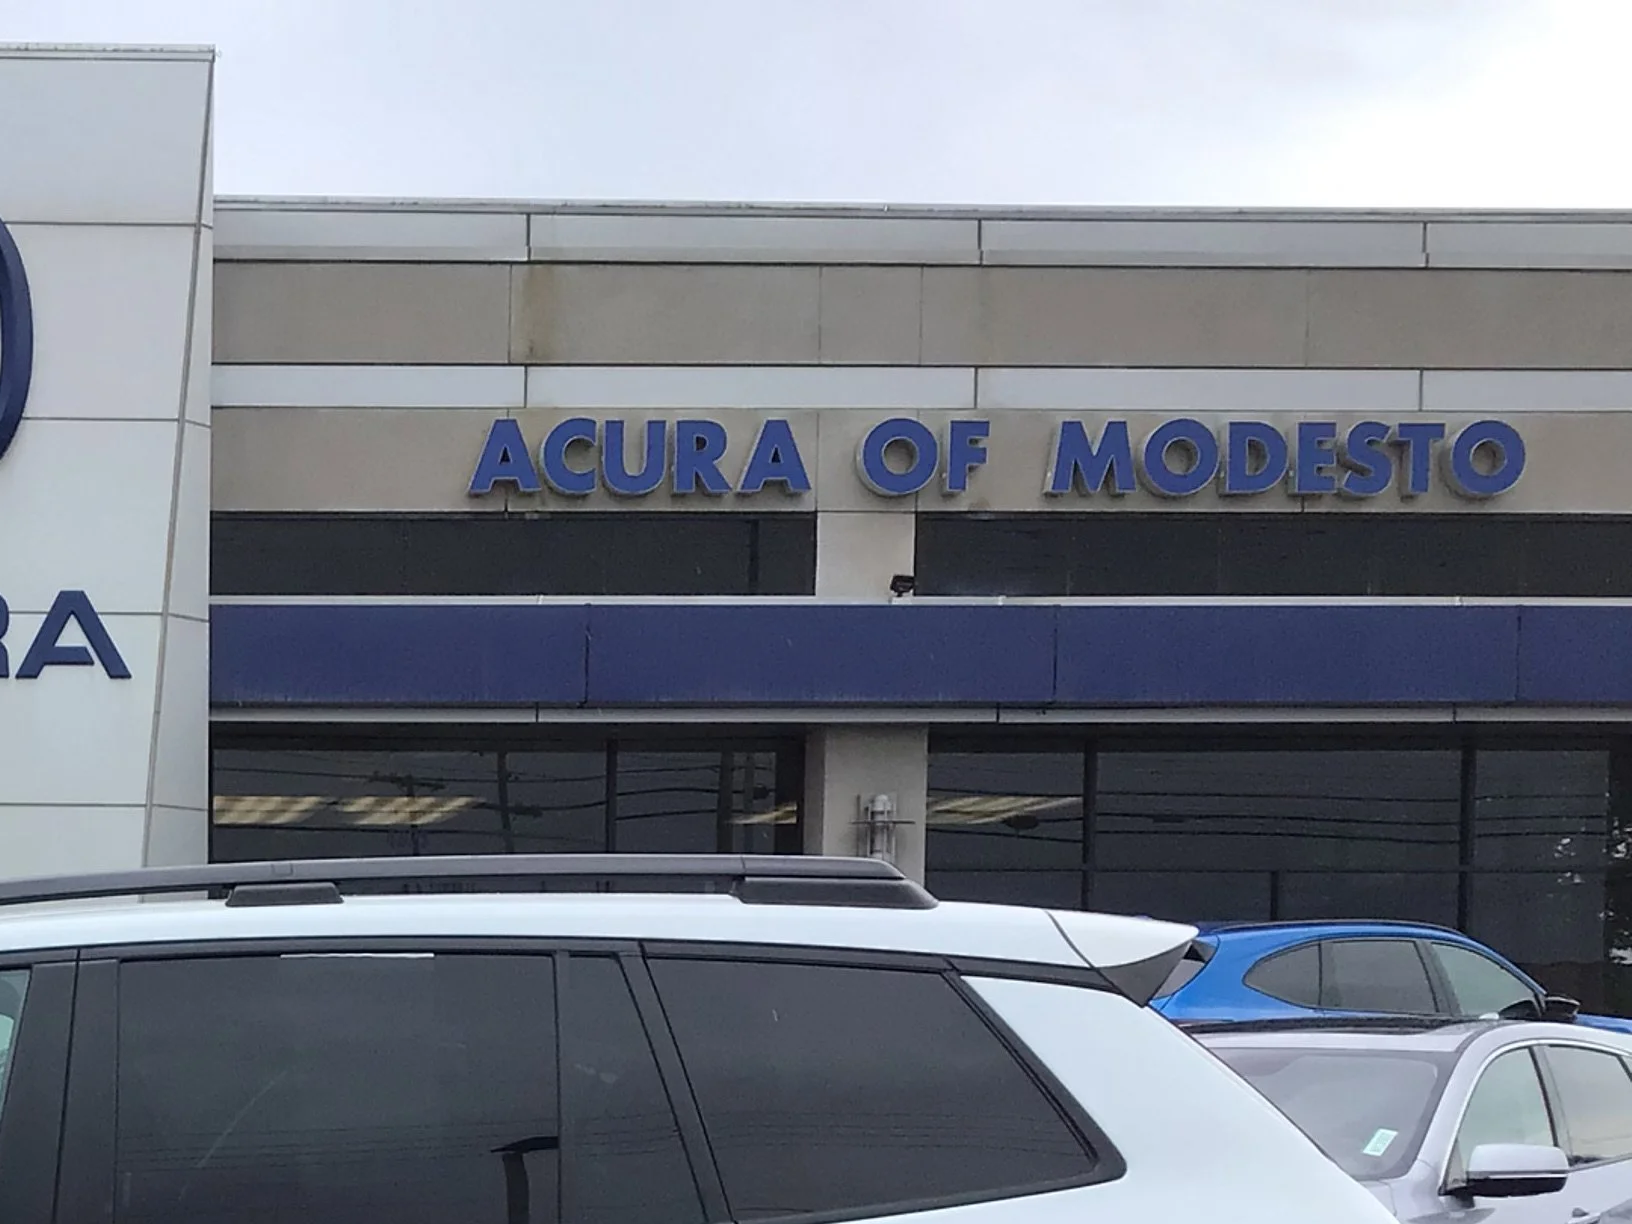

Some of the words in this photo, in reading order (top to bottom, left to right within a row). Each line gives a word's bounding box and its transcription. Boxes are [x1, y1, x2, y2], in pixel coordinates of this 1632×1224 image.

[469, 418, 811, 496] ACURA
[858, 417, 990, 497] OF
[1045, 418, 1527, 497] MODESTO
